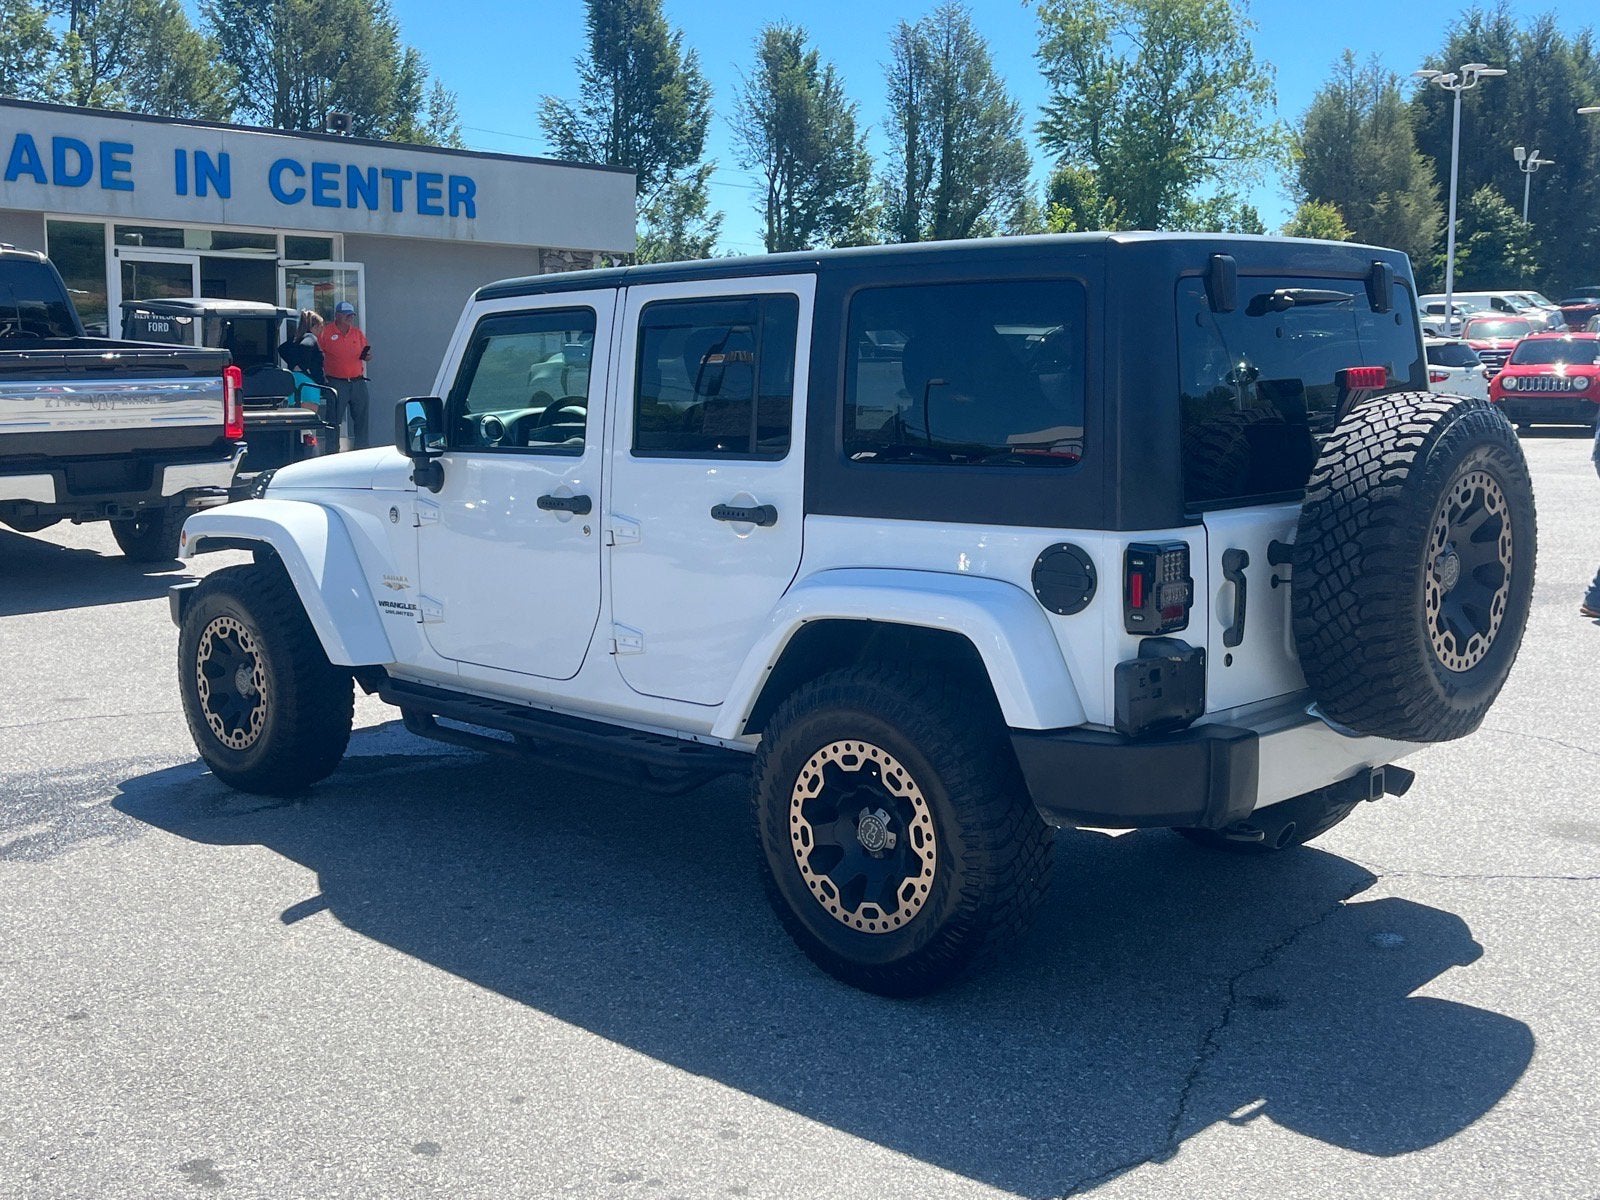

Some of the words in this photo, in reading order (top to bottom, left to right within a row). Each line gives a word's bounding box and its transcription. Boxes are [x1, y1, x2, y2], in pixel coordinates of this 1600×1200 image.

[5, 133, 135, 192] ADE
[174, 148, 231, 199] IN
[268, 158, 477, 219] CENTER
[148, 322, 169, 332] FORD
[378, 600, 417, 610] WRANGLER
